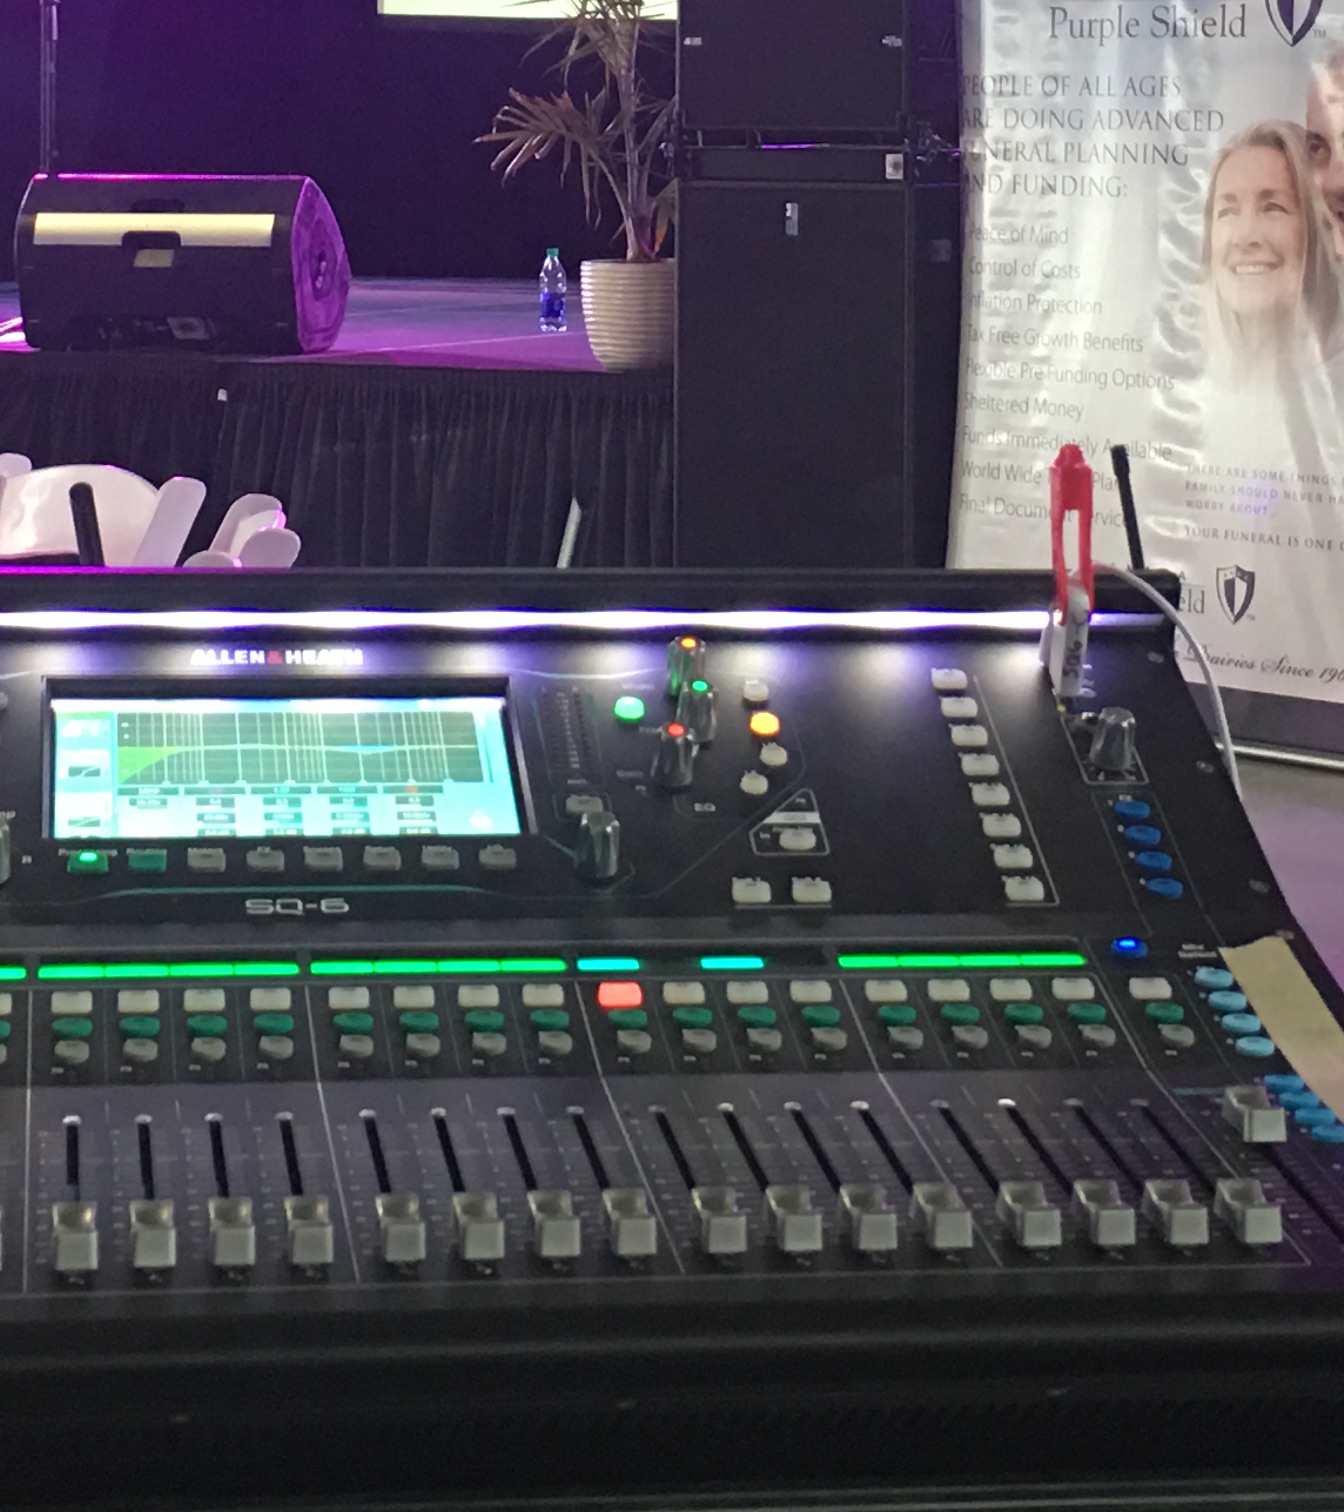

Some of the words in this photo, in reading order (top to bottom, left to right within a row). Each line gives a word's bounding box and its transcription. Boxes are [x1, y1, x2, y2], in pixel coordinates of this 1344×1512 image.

[1049, 4, 1140, 47] Purple
[1150, 3, 1247, 39] Shield
[962, 74, 1033, 98] PEOPLE
[1041, 75, 1071, 98] OF
[1079, 75, 1116, 98] ALL
[1124, 76, 1182, 98] AGES
[962, 107, 991, 130] ARE
[1003, 108, 1084, 131] DOING
[1093, 109, 1225, 132] ADVANCED
[963, 139, 1056, 164] FUNERAL
[1063, 141, 1189, 167] PLANNING
[1012, 174, 1128, 198] FUNDING:
[1010, 225, 1027, 243] of
[1031, 225, 1069, 245] Mind
[968, 255, 1018, 277] Control
[1021, 259, 1039, 278] of
[1040, 260, 1082, 280] Costs
[1026, 293, 1103, 316] Protection
[988, 326, 1021, 346] Free
[1023, 328, 1079, 349] Growth
[1083, 333, 1144, 353] Benefits
[1020, 362, 1044, 381] Pre
[1047, 365, 1108, 390] Funding
[1112, 368, 1176, 392] Options
[963, 391, 1030, 414] Sheltered
[1033, 398, 1085, 423] Money
[961, 425, 1003, 446] Funds
[1006, 428, 1099, 458] Immeditely
[1102, 438, 1173, 461] Ailable
[960, 460, 1001, 481] World
[1004, 463, 1043, 485] Wide
[959, 493, 990, 514] Final
[1184, 524, 1220, 540] YOUR
[1223, 529, 1282, 547] FUNERAL
[1287, 535, 1300, 548] IS
[1304, 537, 1333, 551] ONE
[1260, 654, 1315, 679] Since
[245, 897, 350, 915] SQ-6
